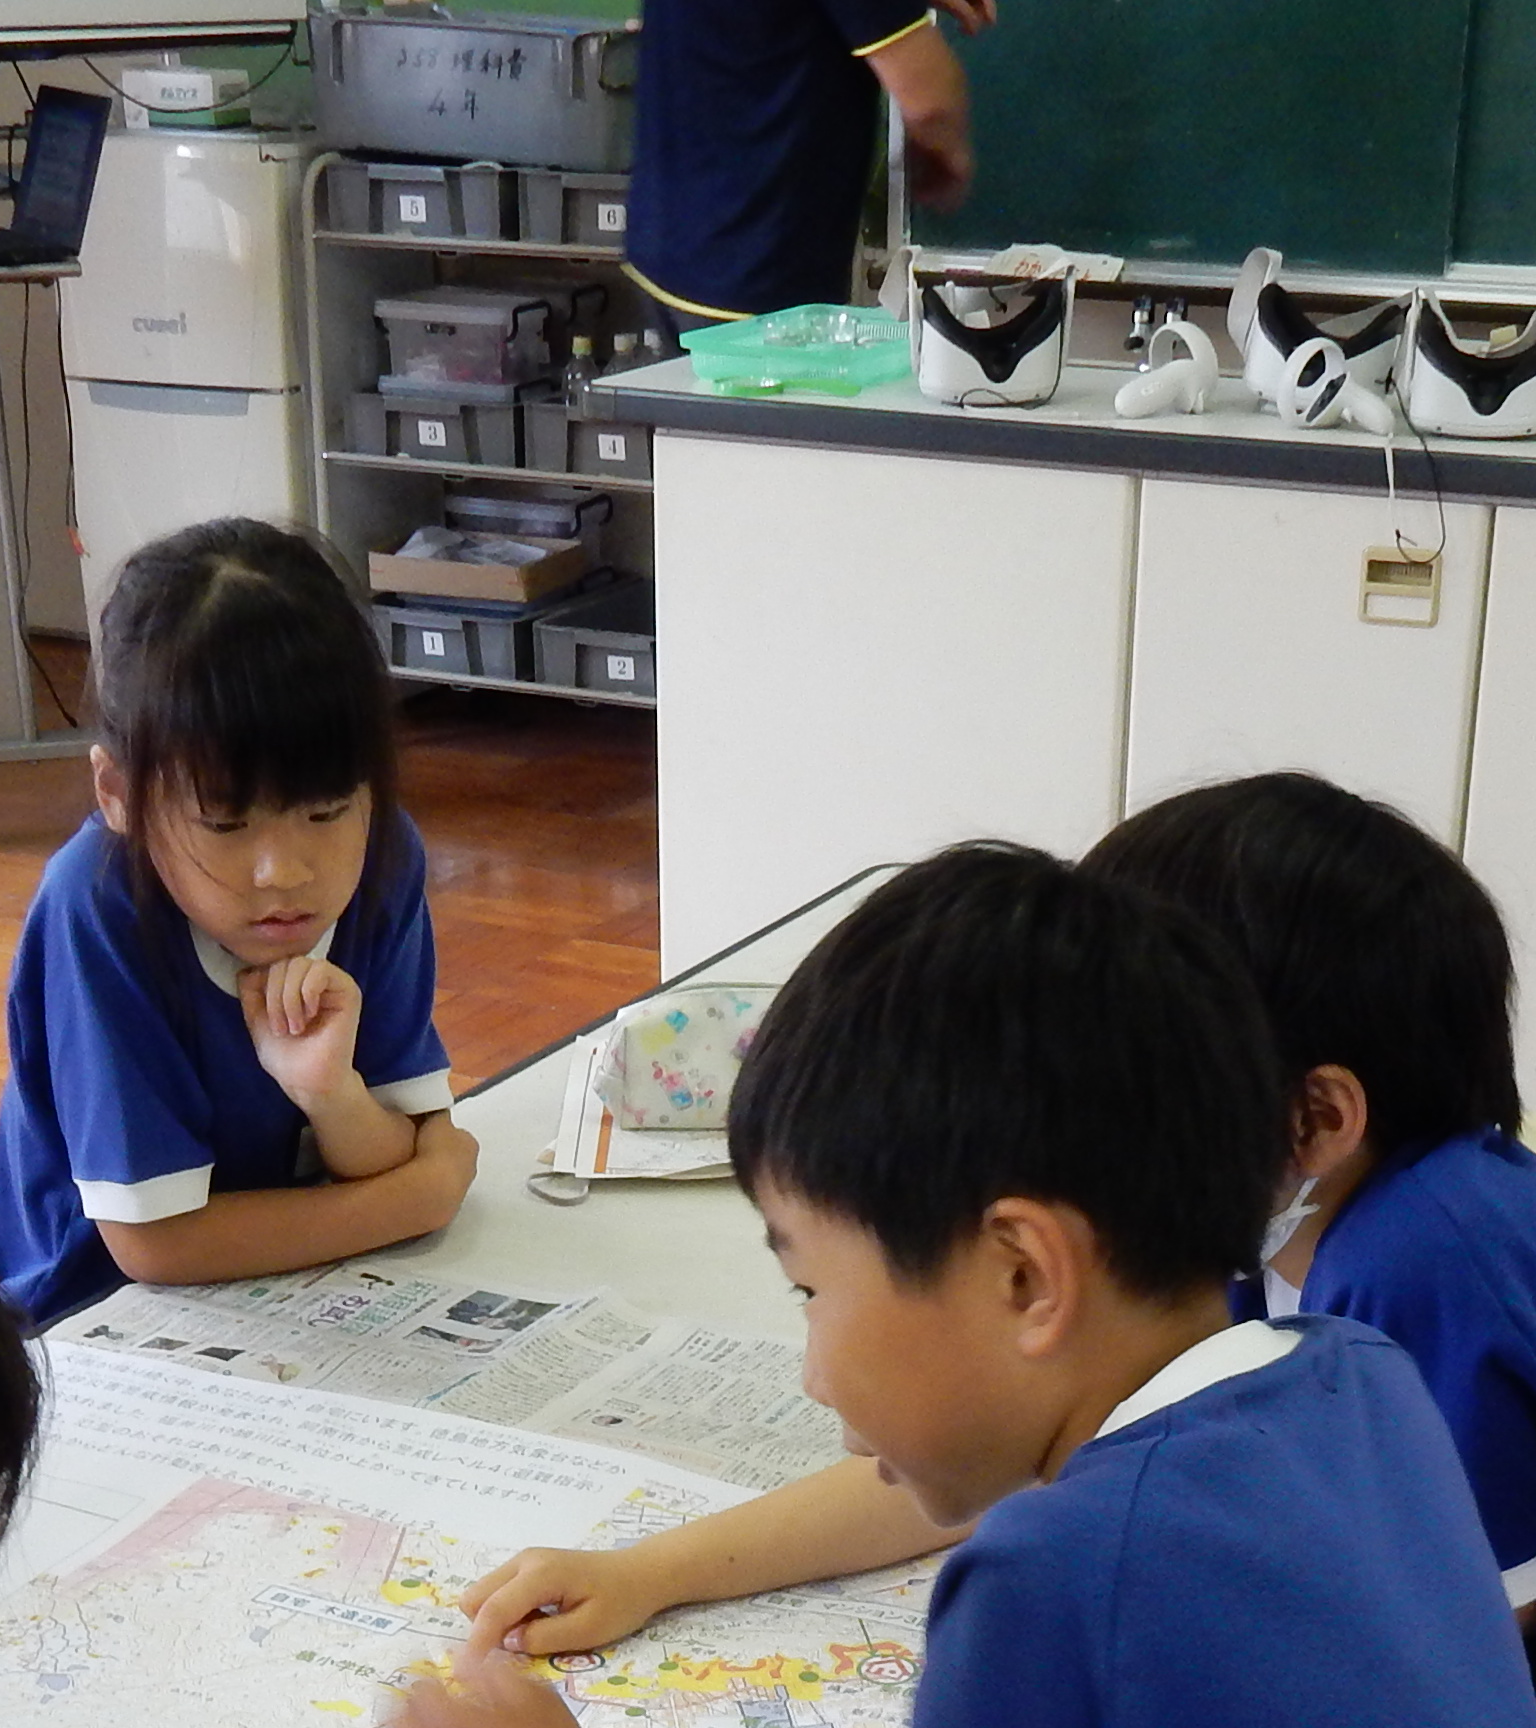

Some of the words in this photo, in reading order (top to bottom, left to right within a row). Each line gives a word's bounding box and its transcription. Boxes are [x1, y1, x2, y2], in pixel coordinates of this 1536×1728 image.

[409, 200, 420, 217] 5
[606, 209, 617, 226] 6
[428, 425, 438, 441] 3
[616, 659, 627, 676] 2
